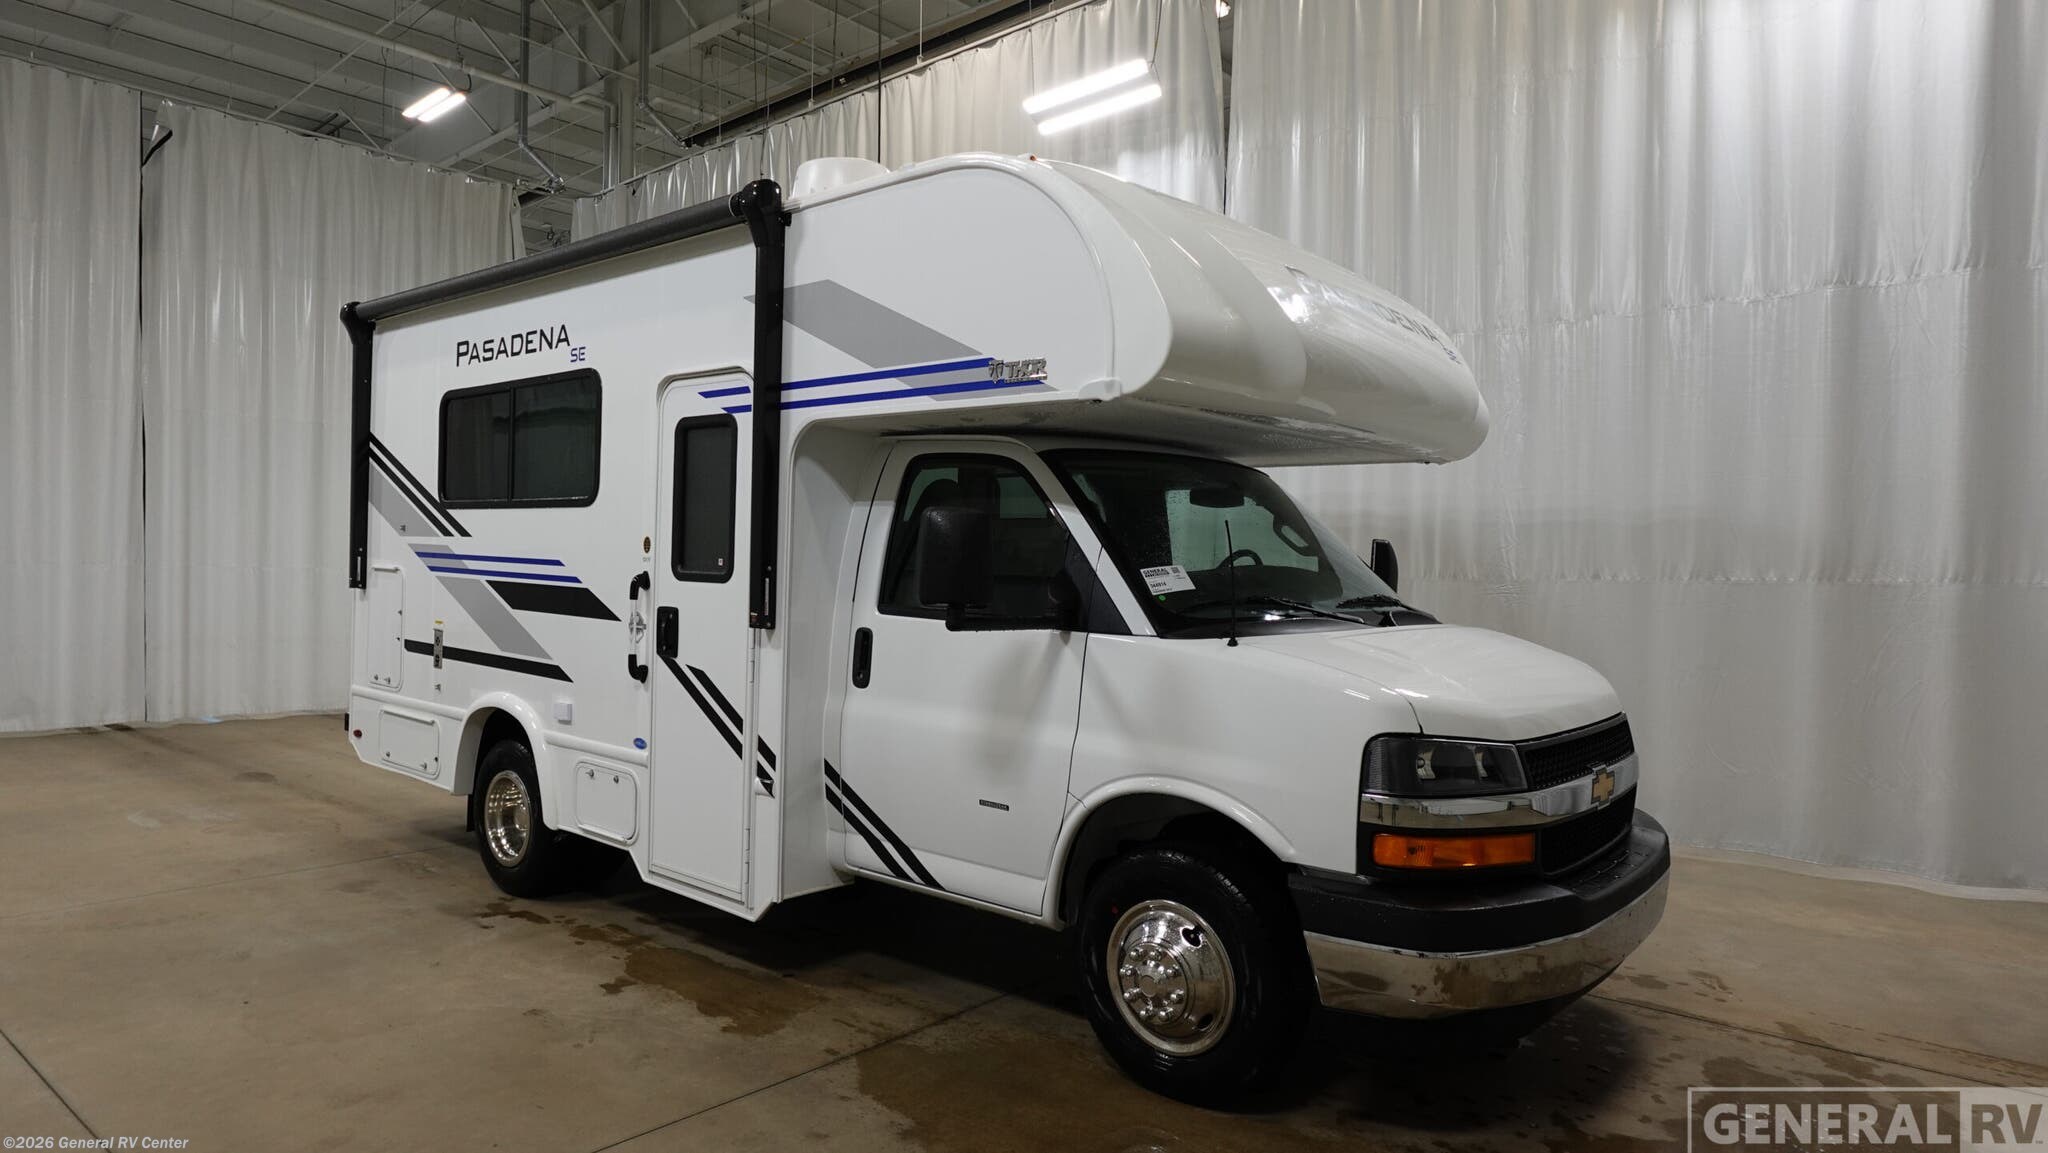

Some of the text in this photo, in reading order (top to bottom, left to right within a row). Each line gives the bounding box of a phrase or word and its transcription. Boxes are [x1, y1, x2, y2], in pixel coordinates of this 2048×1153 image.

[456, 324, 570, 367] PASADENA
[570, 346, 586, 363] SE
[1005, 358, 1047, 378] THOR
